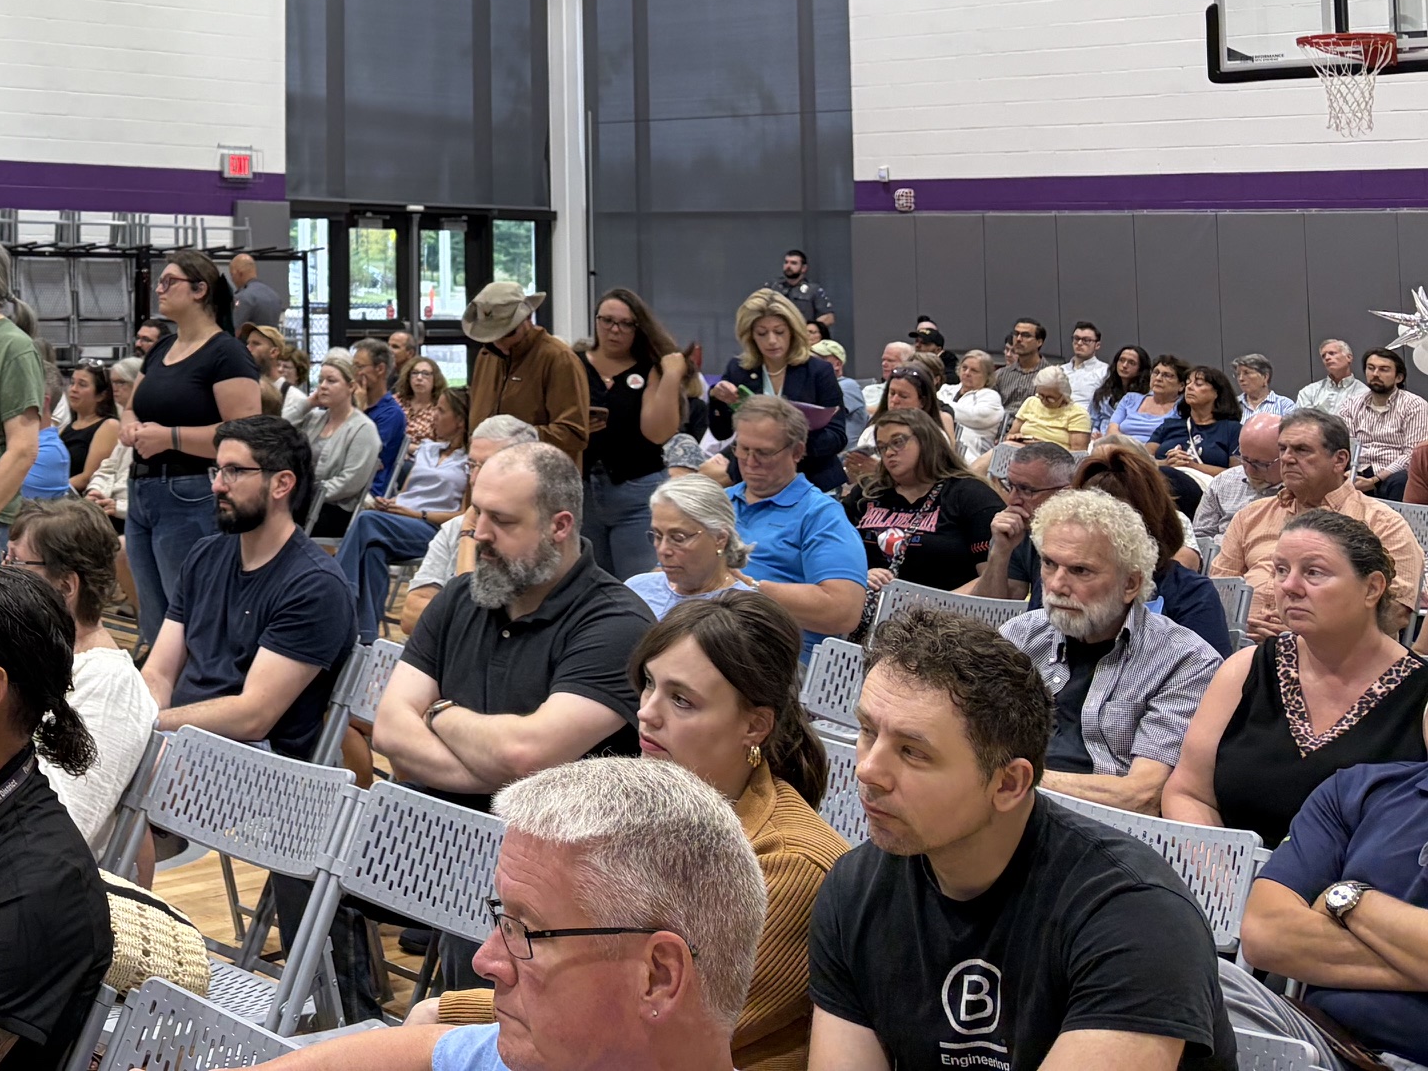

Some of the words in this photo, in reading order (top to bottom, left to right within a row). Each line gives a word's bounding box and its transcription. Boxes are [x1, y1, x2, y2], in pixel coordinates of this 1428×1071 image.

[229, 154, 250, 176] EXIT
[855, 502, 941, 533] PHILADELHIA
[0, 779, 18, 798] District
[959, 974, 994, 1022] B
[940, 1053, 1010, 1071] Engineering
